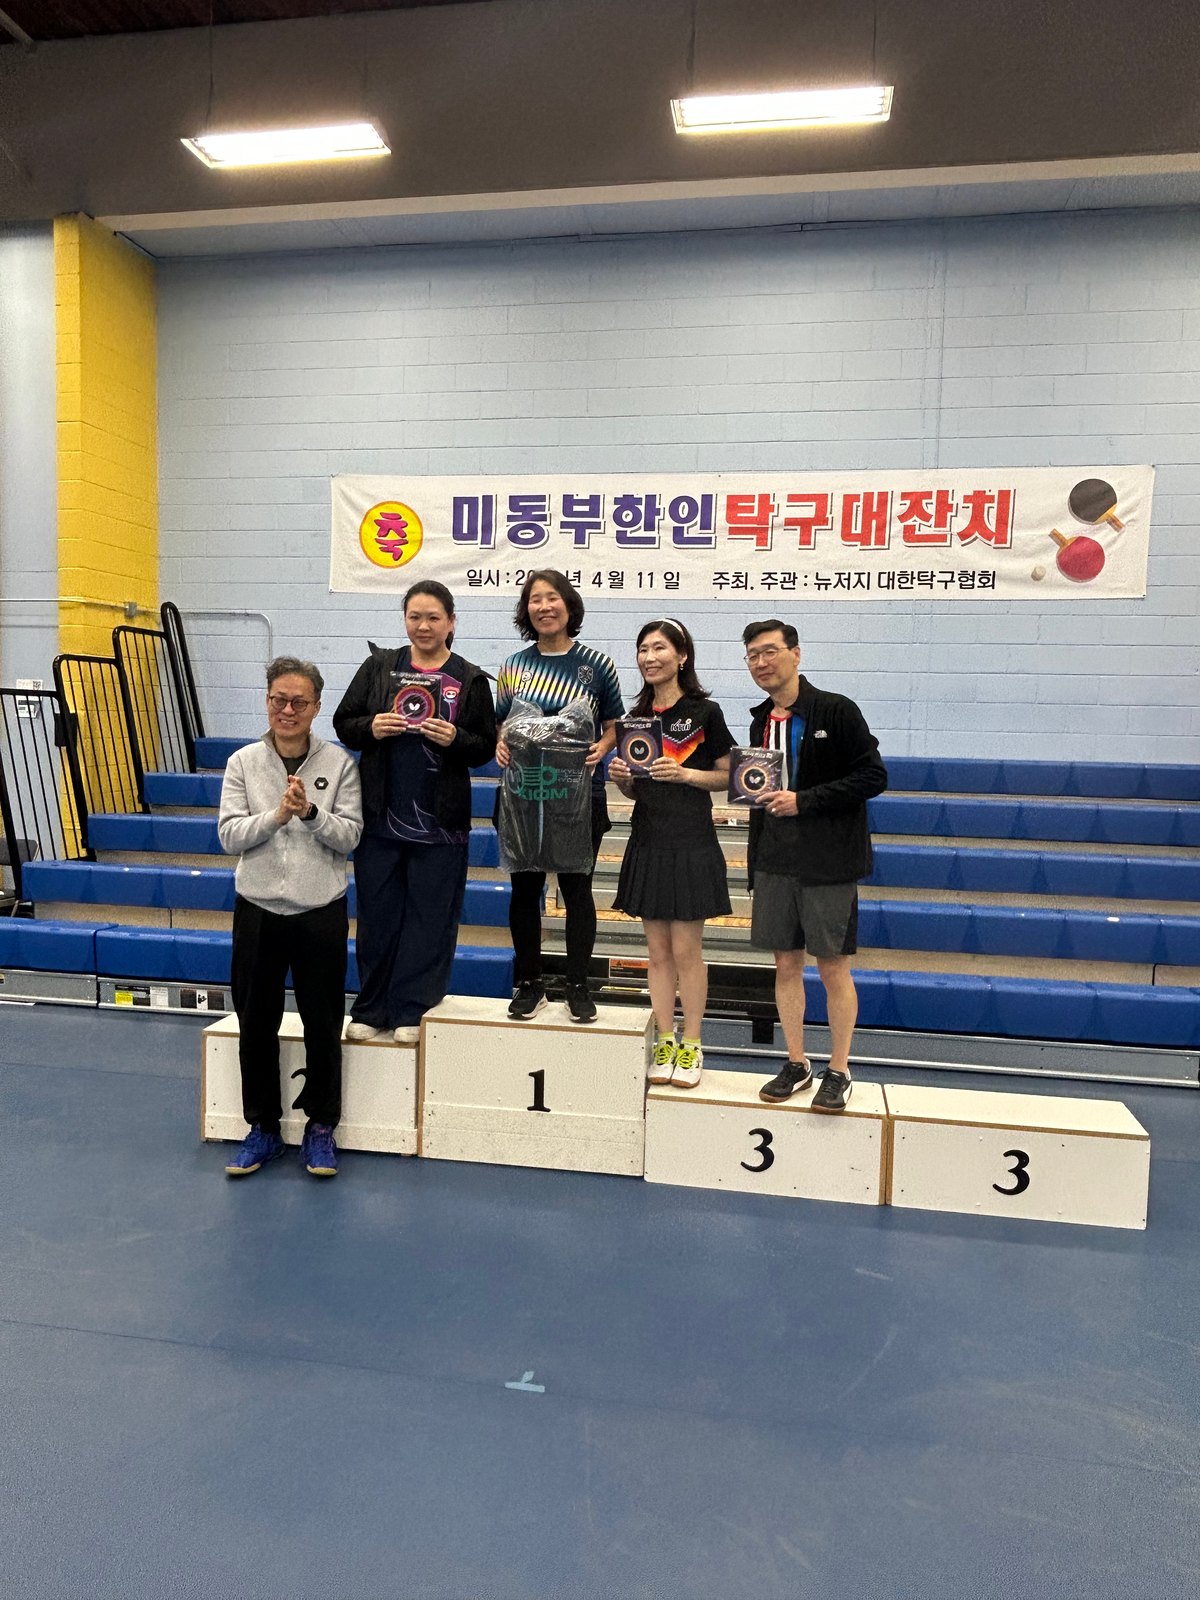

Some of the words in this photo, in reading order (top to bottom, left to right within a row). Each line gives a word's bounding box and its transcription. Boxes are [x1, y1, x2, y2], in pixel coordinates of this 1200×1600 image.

[374, 511, 409, 562] 축
[813, 571, 871, 591] 뉴저지
[877, 570, 996, 590] 대한탁구협회
[526, 1069, 551, 1112] 1
[740, 1128, 775, 1172] 3
[992, 1149, 1030, 1196] 3
